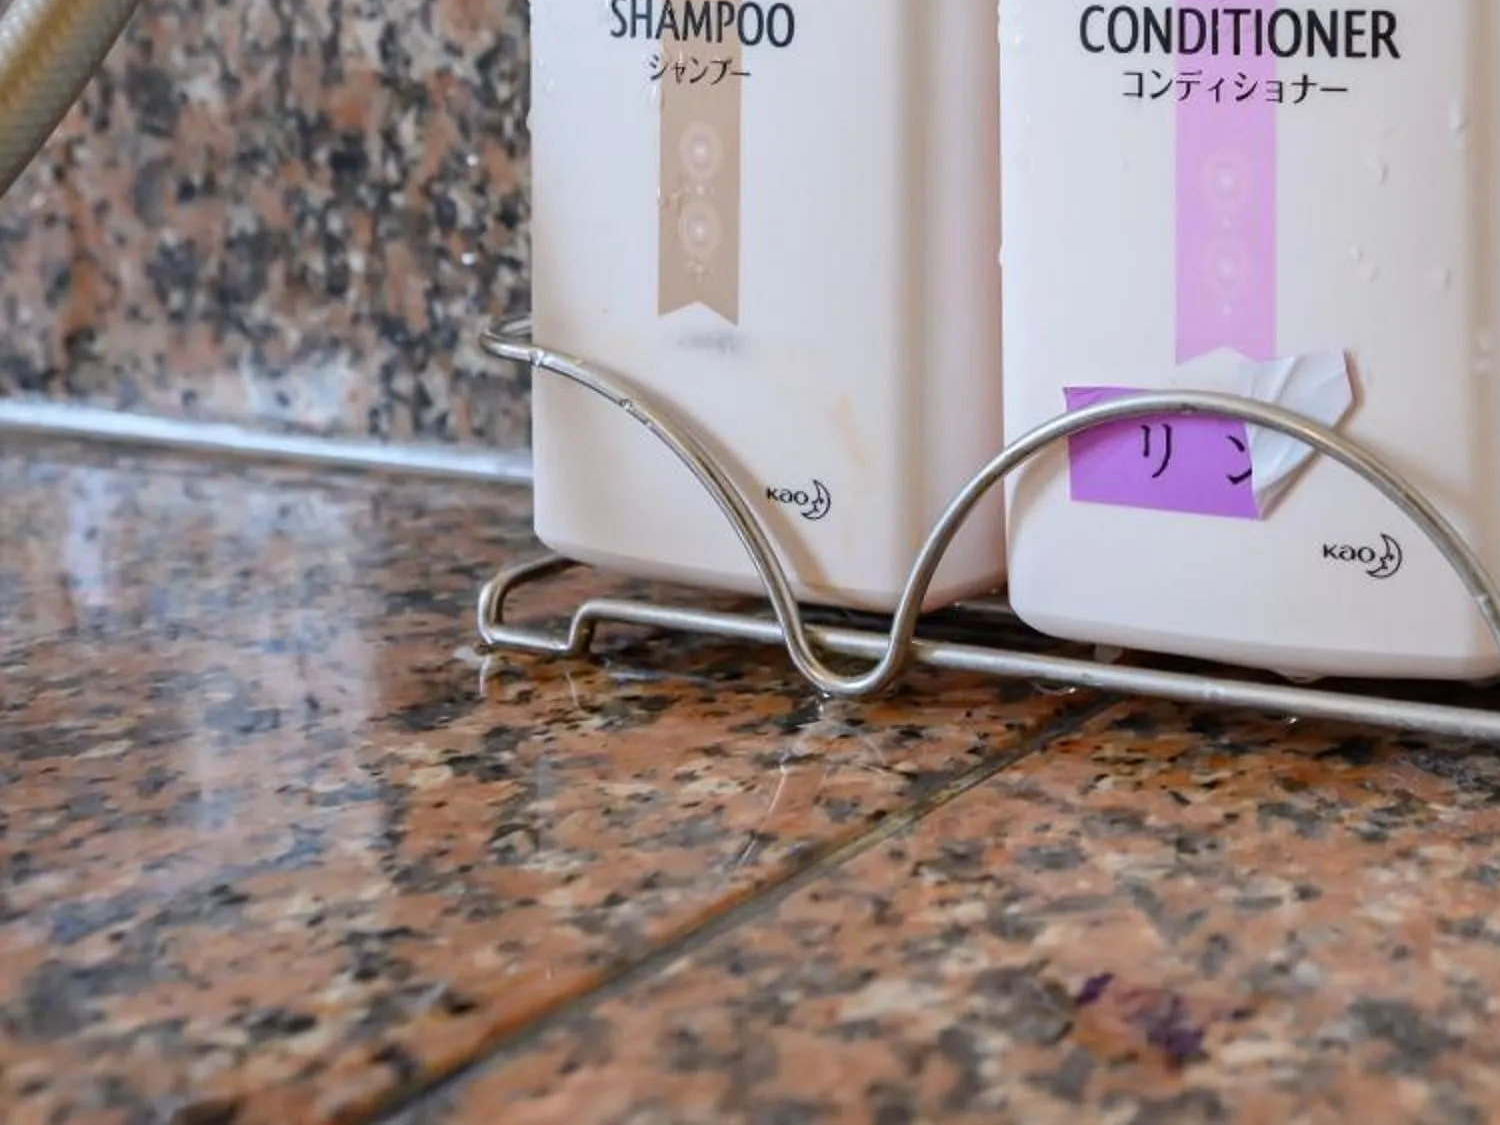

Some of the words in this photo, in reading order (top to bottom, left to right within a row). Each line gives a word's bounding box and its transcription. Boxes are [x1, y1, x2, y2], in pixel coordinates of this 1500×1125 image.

[1079, 5, 1400, 59] CONDITIONER
[1122, 70, 1348, 104] コンディショナー
